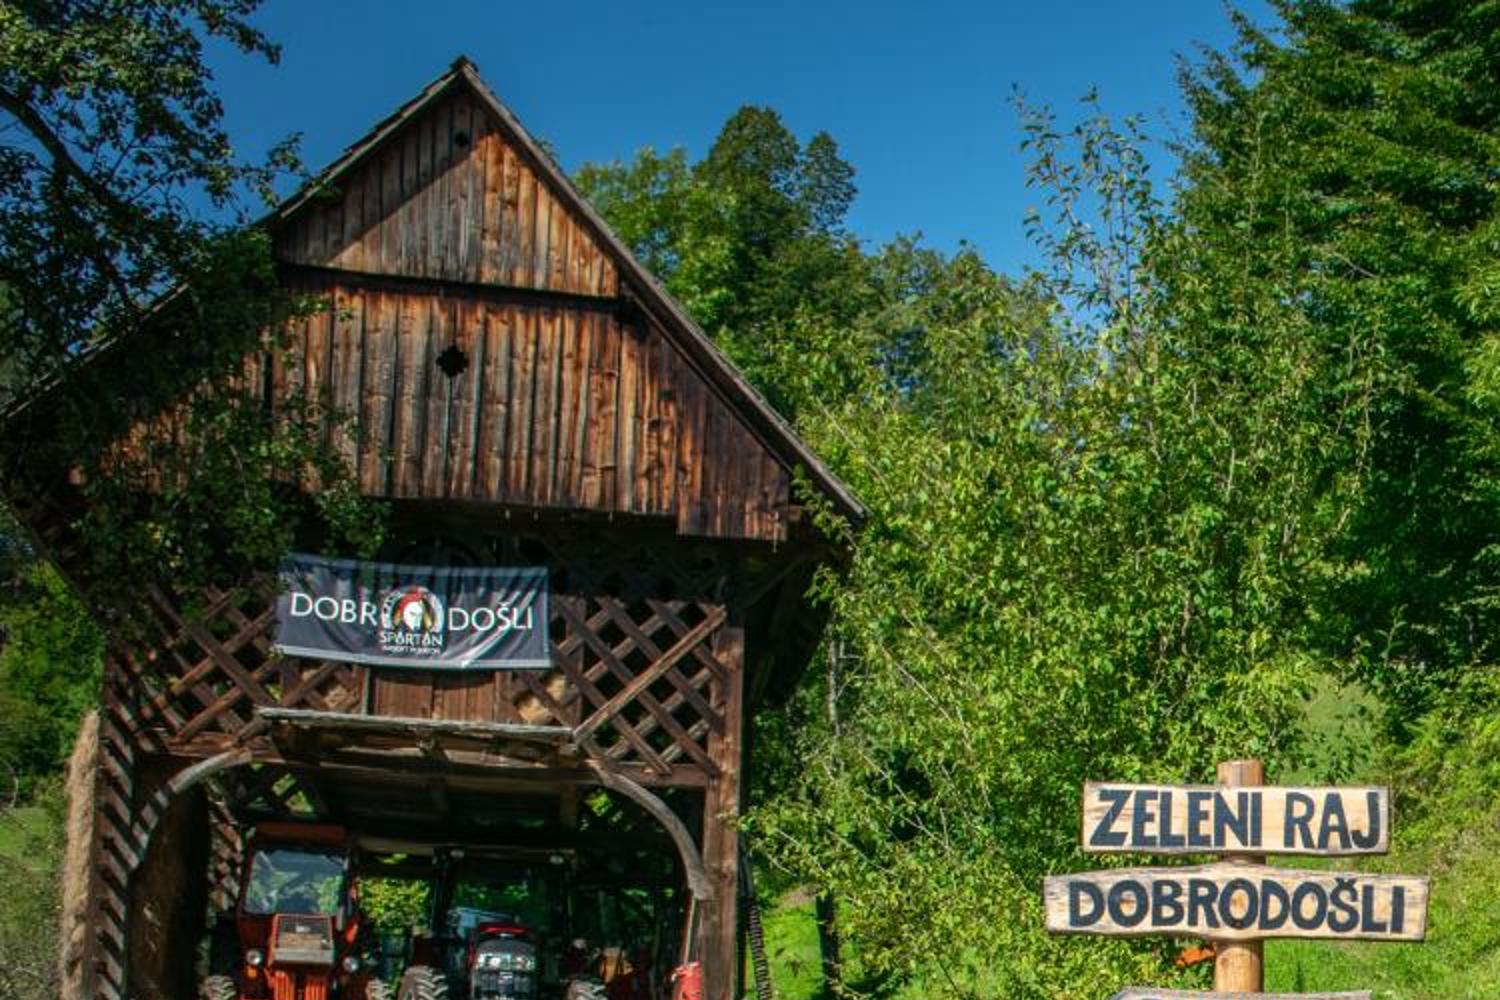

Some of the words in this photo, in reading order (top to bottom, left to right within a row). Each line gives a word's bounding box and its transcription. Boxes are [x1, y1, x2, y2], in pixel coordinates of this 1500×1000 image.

[447, 601, 534, 632] DOŠLI
[379, 631, 444, 647] SPARTAN
[1089, 789, 1263, 848] ZELENI
[1284, 791, 1380, 849] RAJ
[1068, 877, 1405, 933] DOBRODOŠLI
